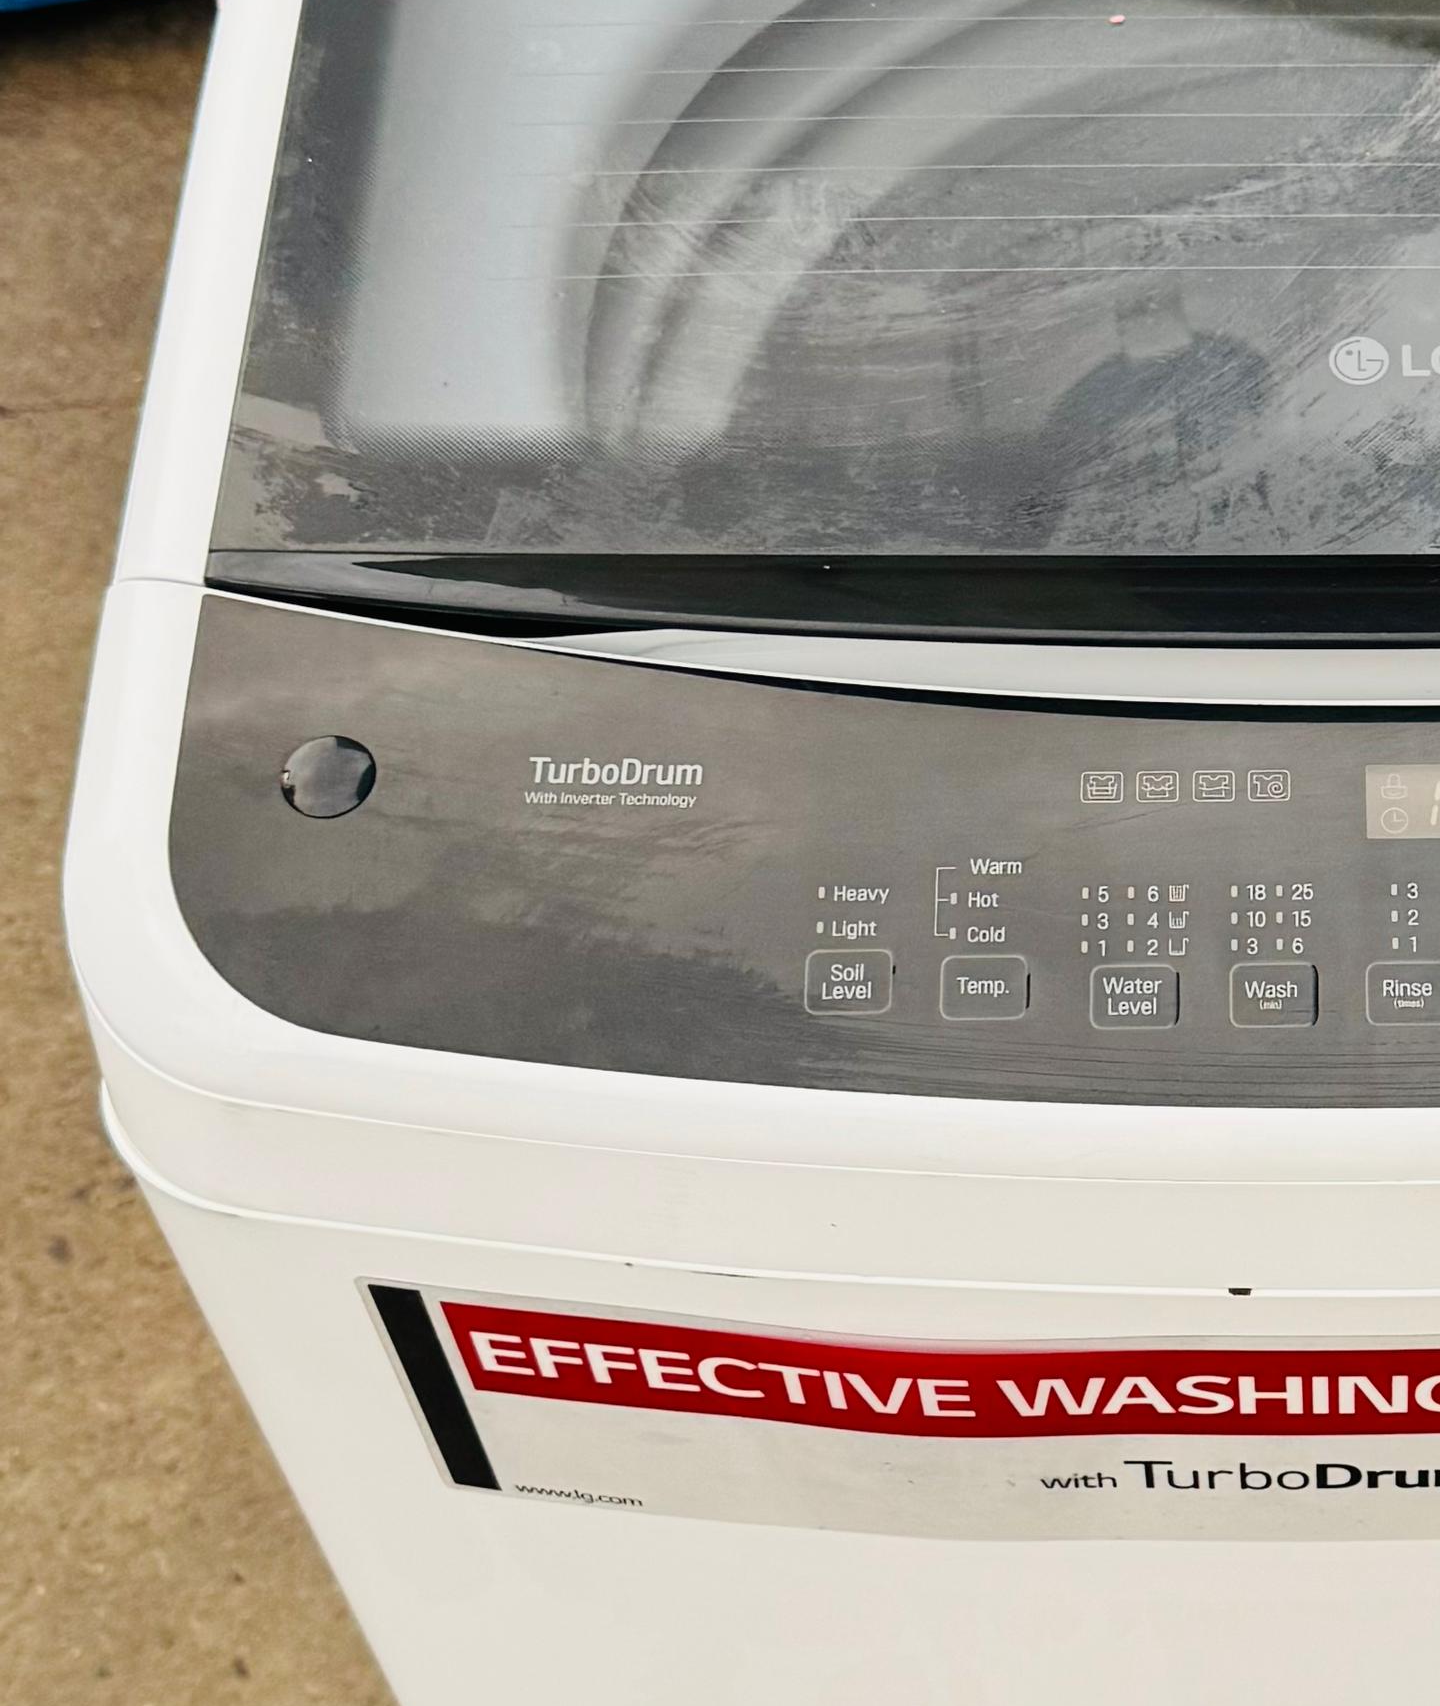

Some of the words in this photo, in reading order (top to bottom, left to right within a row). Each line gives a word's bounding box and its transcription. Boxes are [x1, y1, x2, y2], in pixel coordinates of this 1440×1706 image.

[529, 757, 702, 785] TurboDrum
[525, 792, 557, 804] With
[560, 793, 615, 805] Inverter
[619, 793, 696, 808] Technology
[970, 859, 1022, 874] Warm
[833, 886, 889, 903] Heavy
[1098, 886, 1109, 902] 5
[1148, 886, 1158, 902] 6
[1248, 884, 1266, 900] 18
[1291, 883, 1313, 900] 25
[1407, 883, 1418, 899] 3
[968, 893, 999, 908] Hot
[1097, 913, 1109, 929] 3
[1147, 913, 1158, 928] 4
[1248, 912, 1266, 927] 10
[1292, 911, 1311, 926] 15
[1408, 910, 1418, 925] 2
[832, 921, 877, 939] Light
[967, 927, 1005, 942] Cold
[1099, 940, 1106, 956] 1
[1147, 940, 1158, 955] 2
[1247, 938, 1258, 954] 3
[1292, 938, 1303, 953] 6
[1410, 937, 1417, 952] 1
[831, 964, 864, 981] Soil
[822, 982, 871, 1000] Level
[956, 977, 1009, 997] Temp.
[1103, 977, 1162, 995] Water
[1245, 981, 1298, 998] Wash
[1383, 979, 1432, 997] Rinse
[1107, 998, 1156, 1015] Level
[1260, 1000, 1282, 1010] (min)
[469, 1330, 977, 1418] EFFECTIVE
[1041, 1472, 1116, 1489] with
[515, 1485, 643, 1506] www.lg.com
